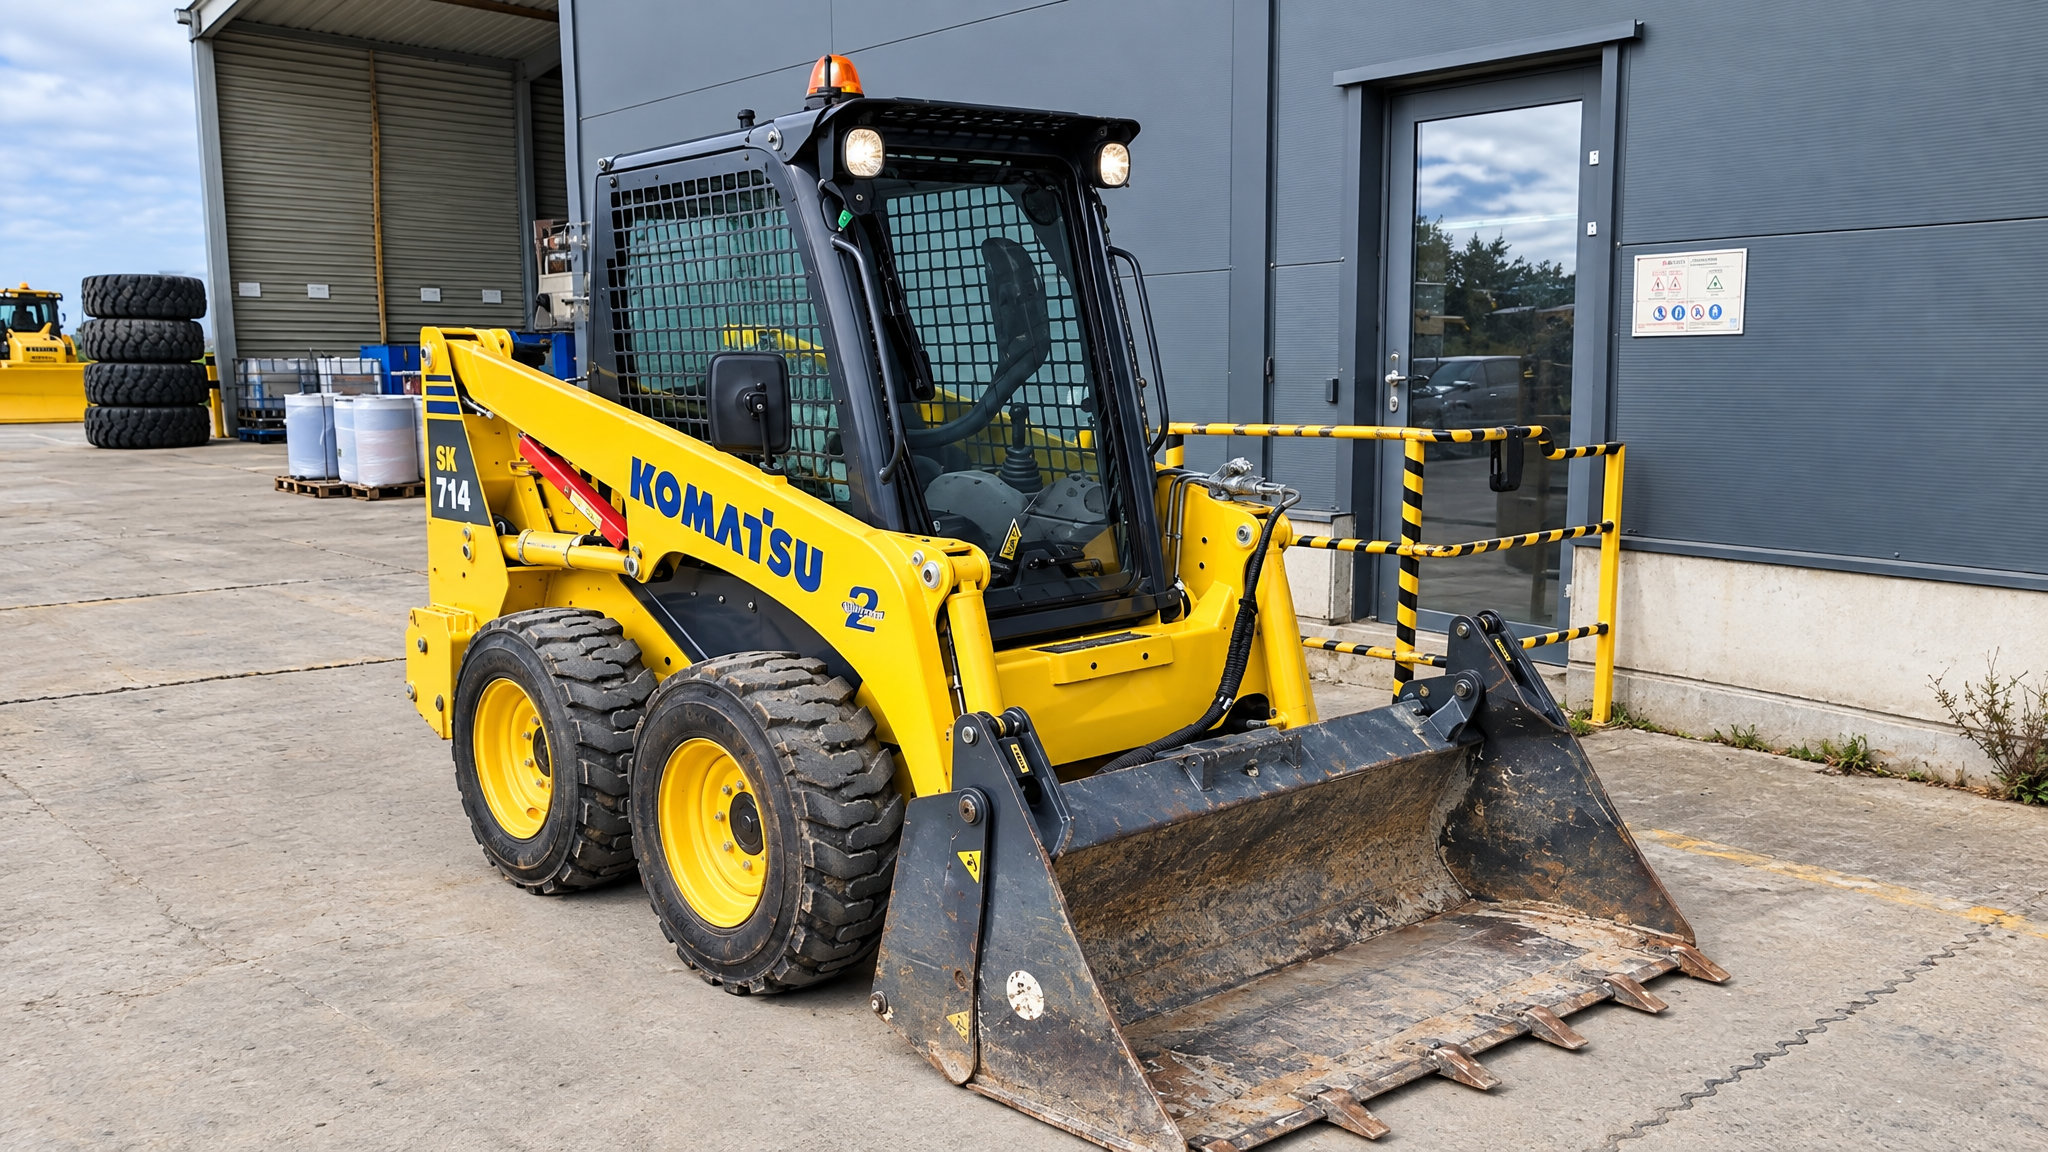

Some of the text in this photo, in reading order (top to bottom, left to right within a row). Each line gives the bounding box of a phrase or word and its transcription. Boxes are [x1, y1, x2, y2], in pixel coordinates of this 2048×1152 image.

[436, 445, 458, 472] SK
[436, 476, 471, 512] 714
[630, 456, 824, 592] KOMATSU
[845, 586, 878, 632] 2
